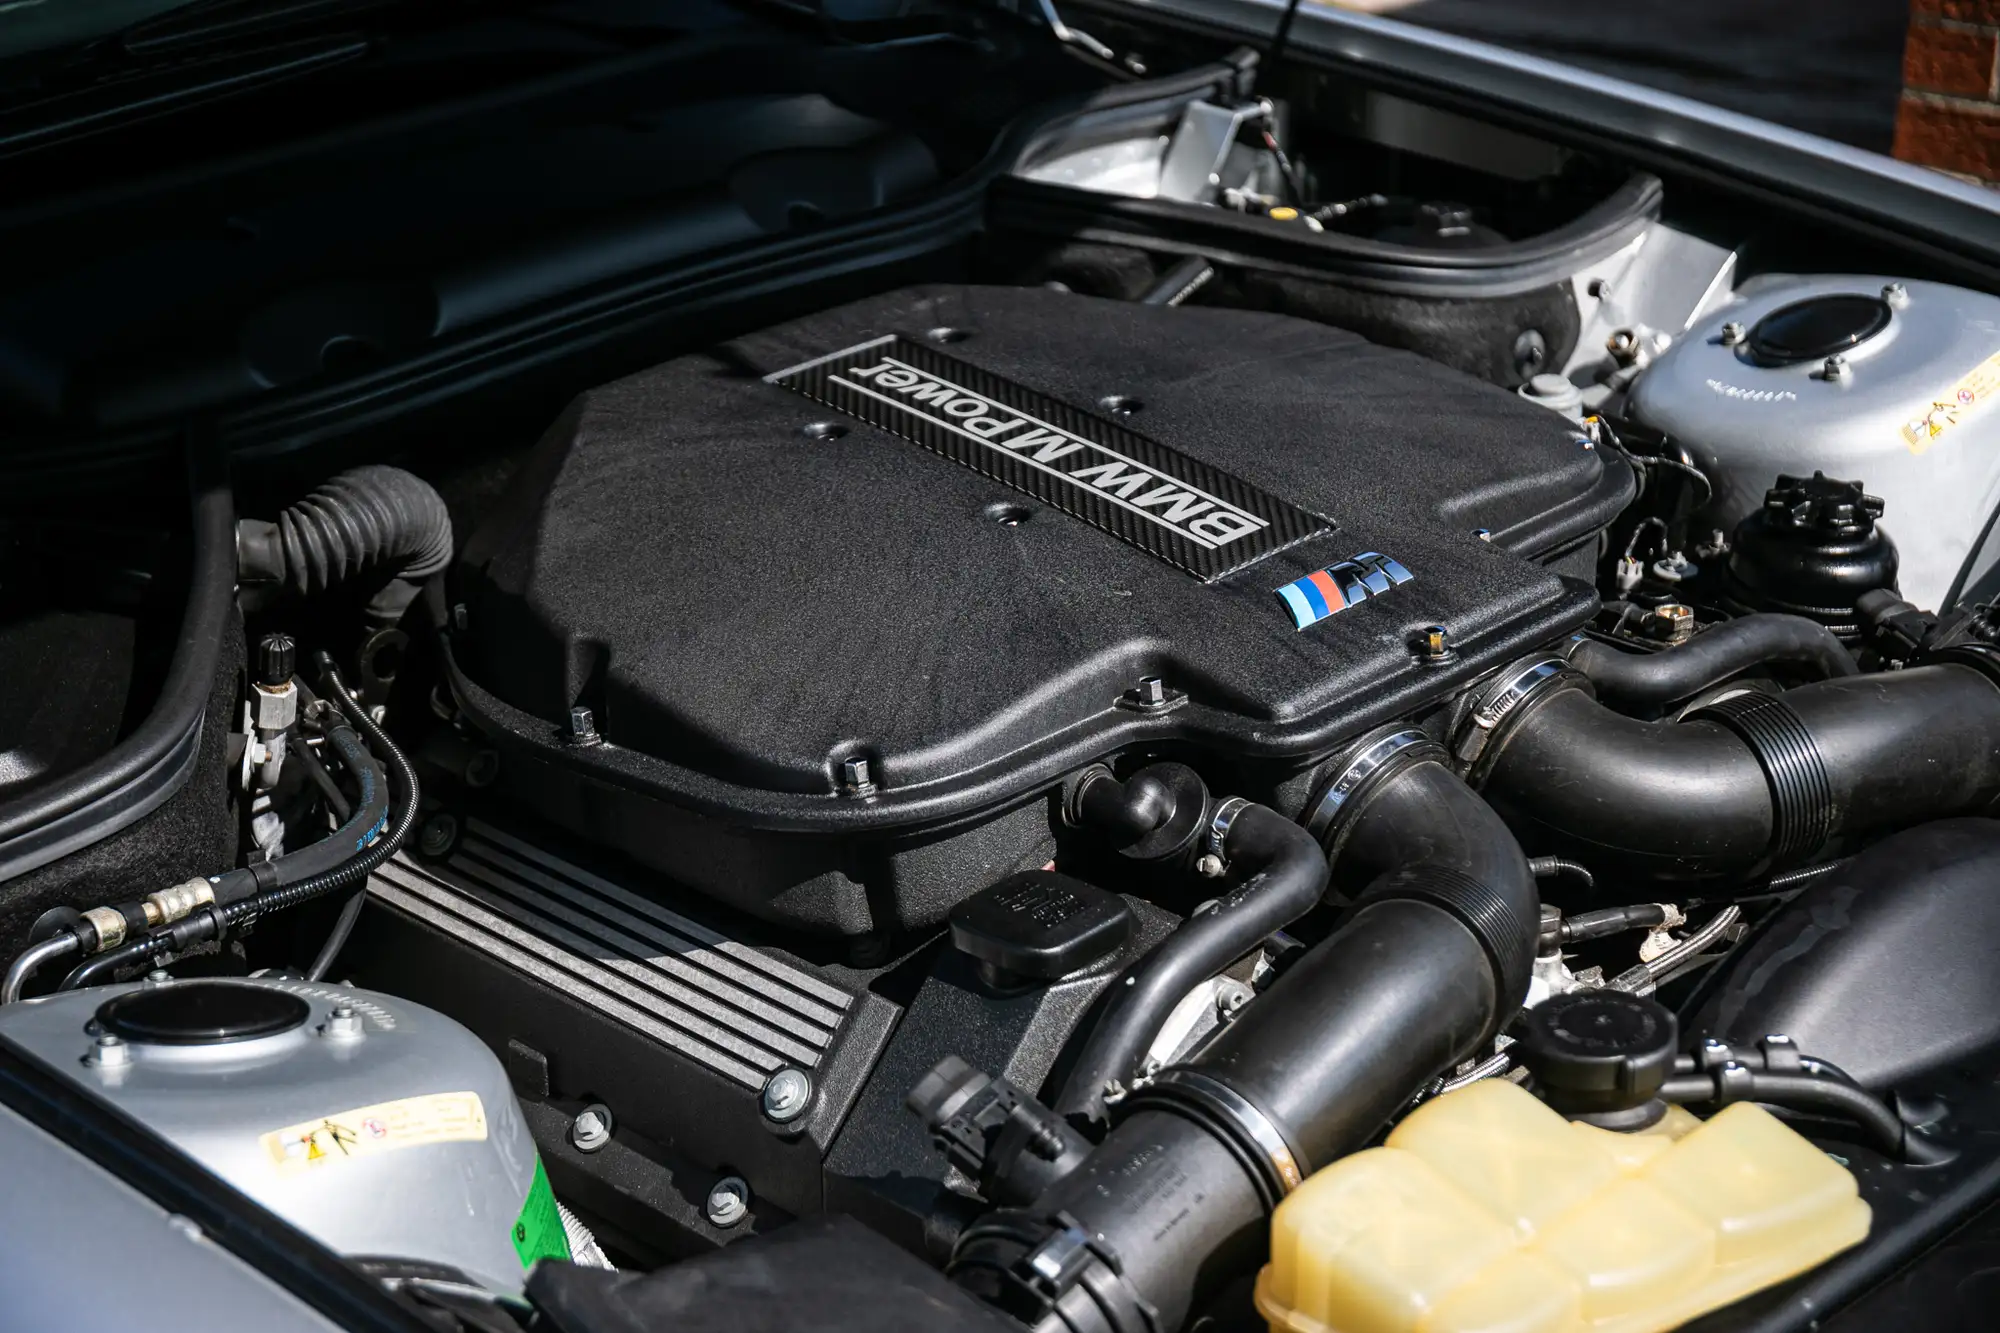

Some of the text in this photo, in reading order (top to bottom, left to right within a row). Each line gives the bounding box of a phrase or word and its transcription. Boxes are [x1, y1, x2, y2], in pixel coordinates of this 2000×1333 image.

[848, 362, 1263, 547] BMW M Power
